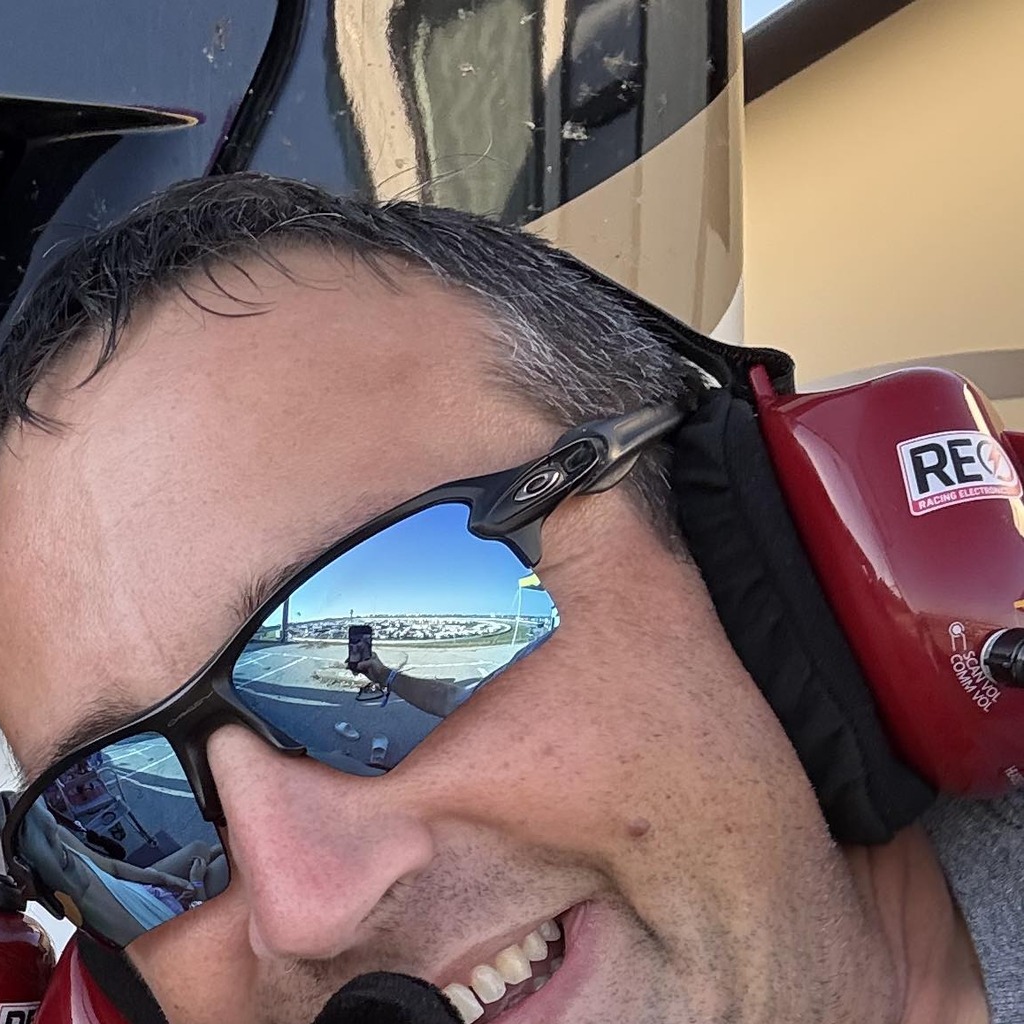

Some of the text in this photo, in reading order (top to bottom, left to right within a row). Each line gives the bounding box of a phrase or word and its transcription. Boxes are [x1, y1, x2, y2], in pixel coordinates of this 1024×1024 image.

[918, 491, 958, 510] RACING
[950, 653, 994, 713] COMM VOL
[962, 650, 1002, 703] SCAN VOL
